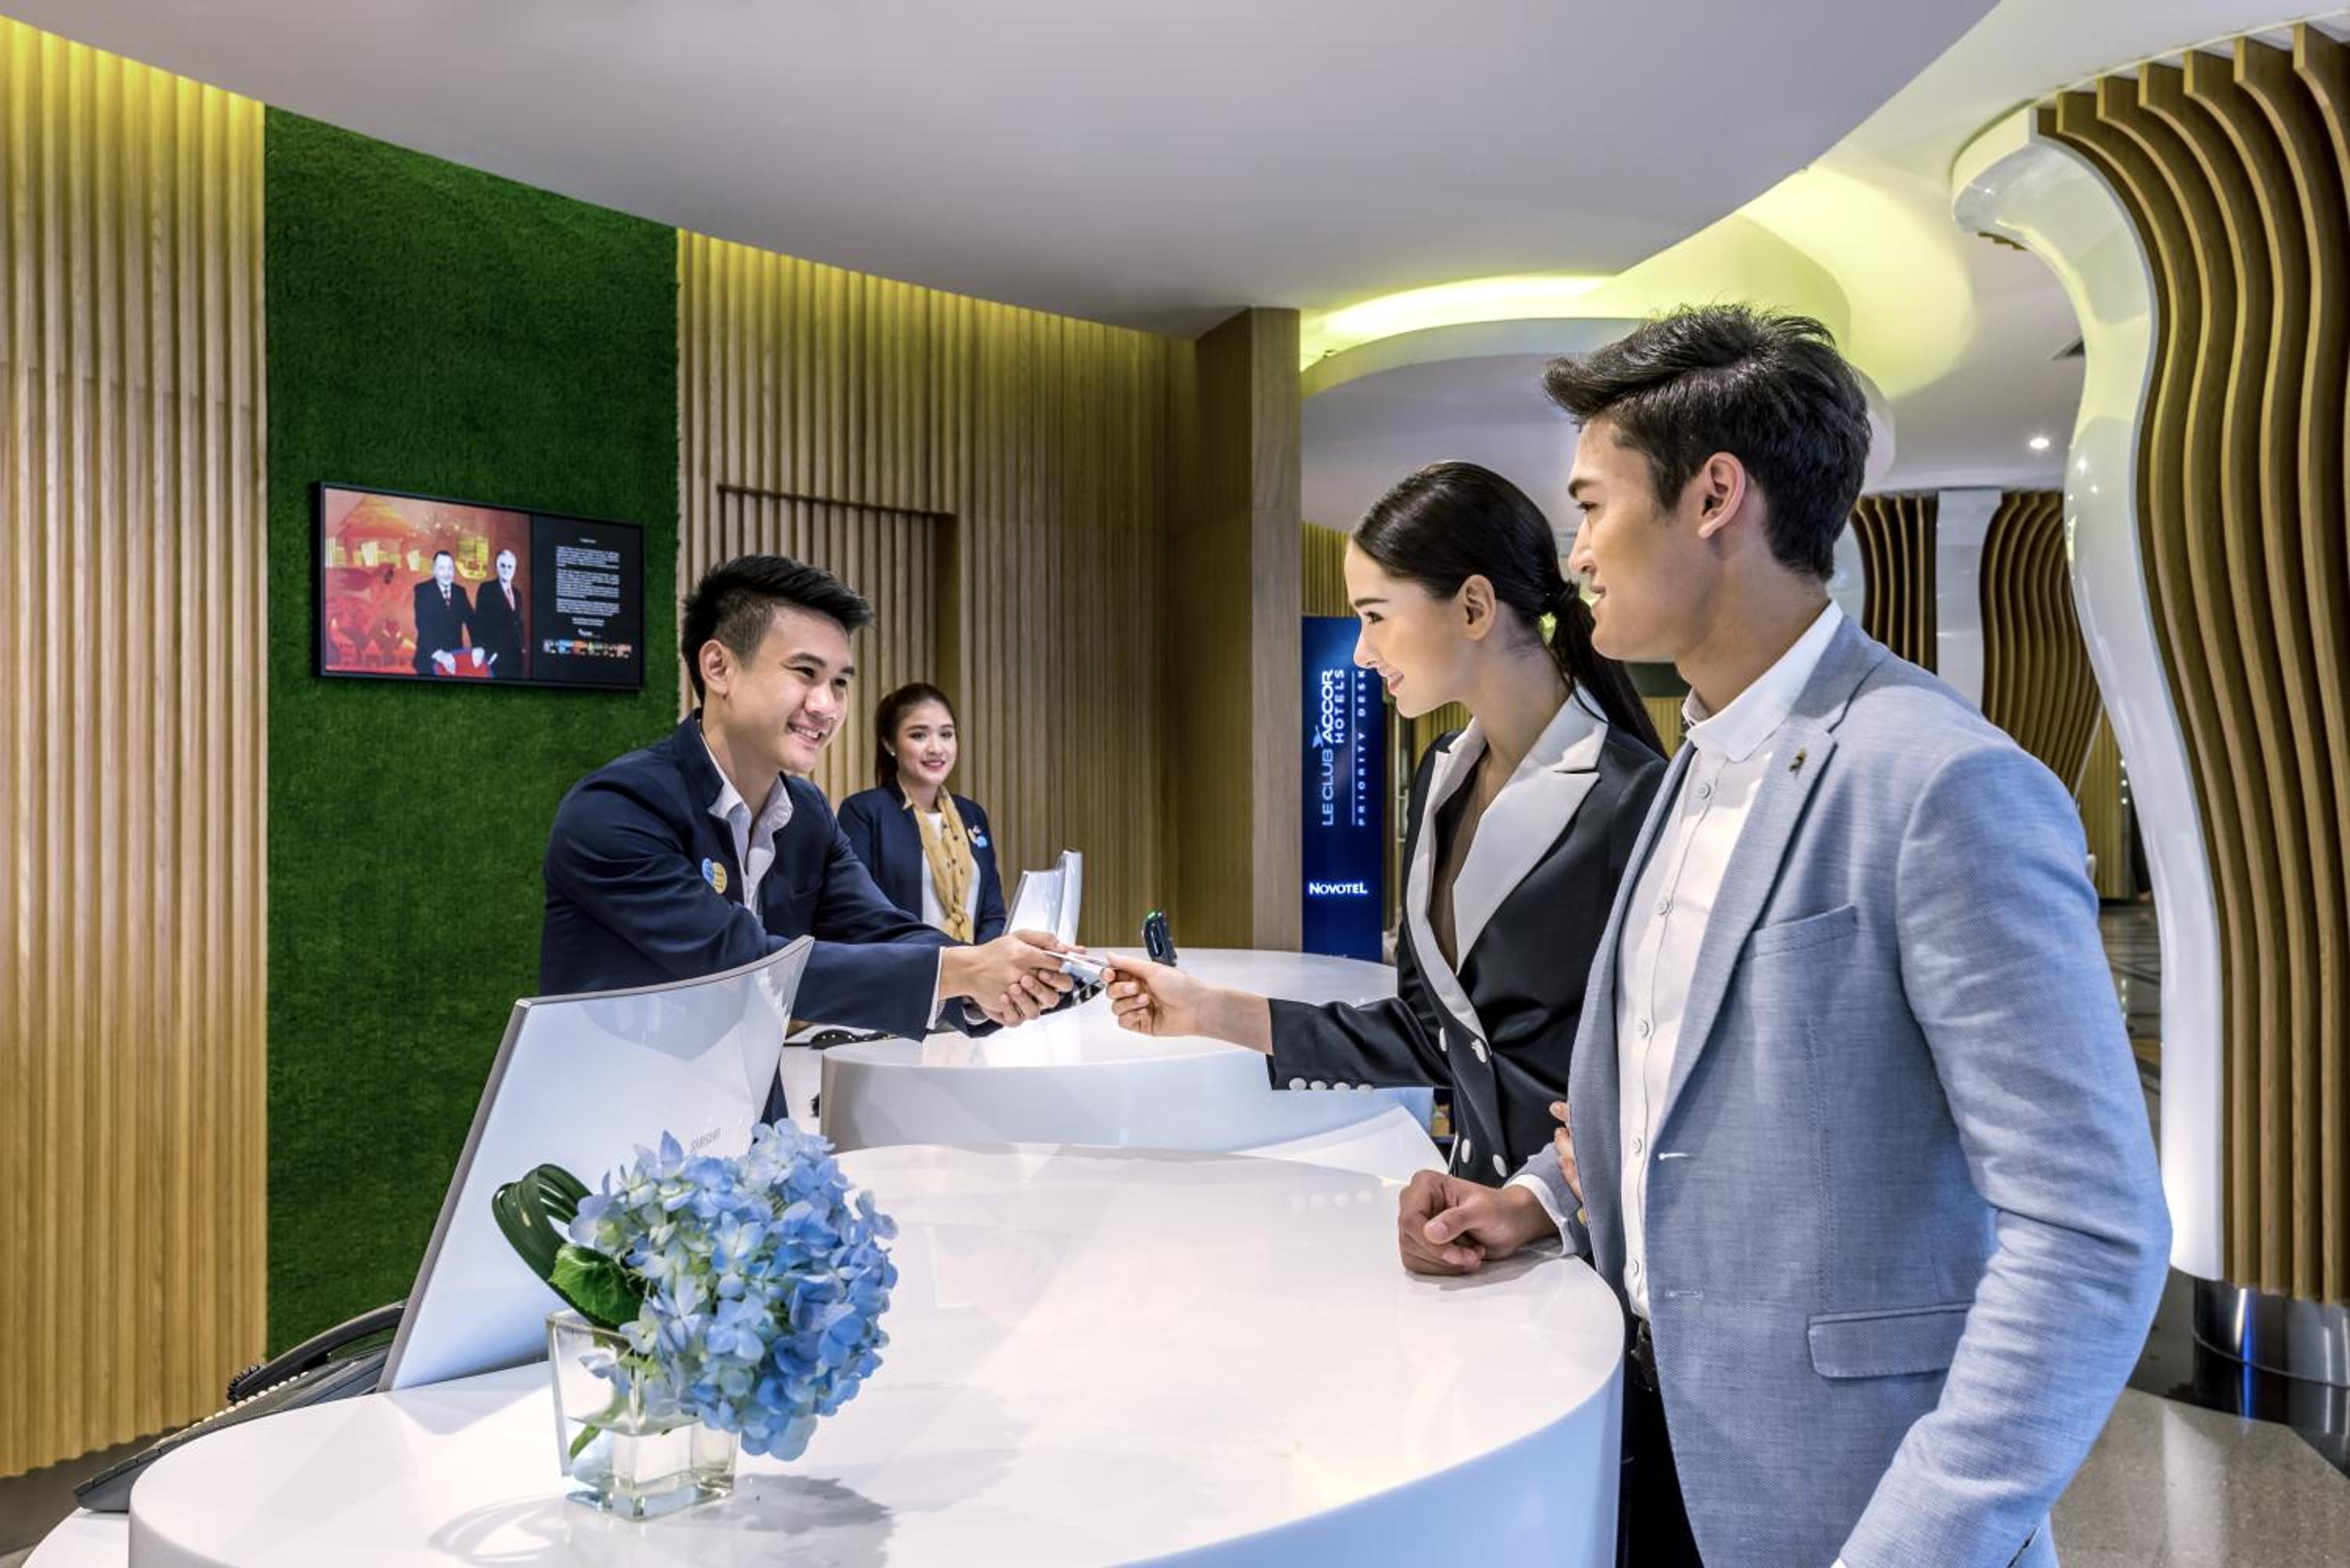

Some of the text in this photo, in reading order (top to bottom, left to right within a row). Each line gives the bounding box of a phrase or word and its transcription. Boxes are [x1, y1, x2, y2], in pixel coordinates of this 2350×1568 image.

[1321, 669, 1334, 826] LE CLUB ACCOR
[1334, 669, 1345, 744] HOTELS
[1358, 670, 1366, 826] PRIORITY DESK
[1309, 882, 1368, 894] NOVOTEL
